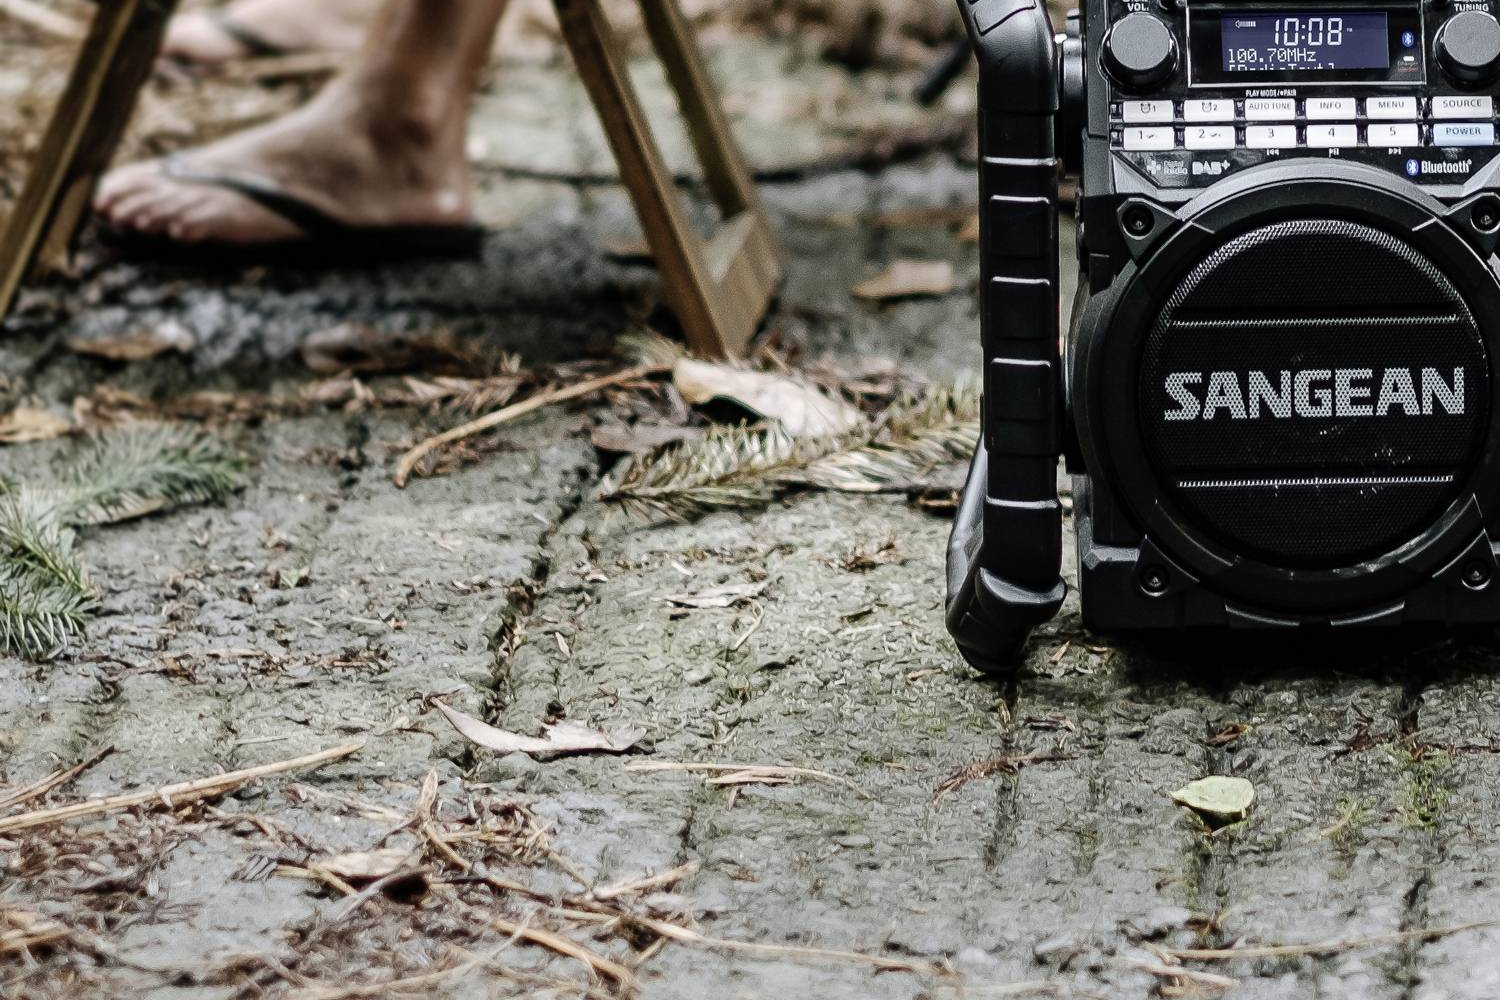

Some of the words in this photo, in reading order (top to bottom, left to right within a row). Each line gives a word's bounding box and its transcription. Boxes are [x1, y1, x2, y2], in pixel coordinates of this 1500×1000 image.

[1454, 3, 1489, 12] TUNING
[1274, 18, 1342, 46] 10:08
[1228, 48, 1317, 62] 100.70MHz
[1245, 89, 1260, 97] PLAY
[1249, 102, 1270, 110] AUTO
[1272, 102, 1291, 110] TUNE
[1319, 102, 1342, 110] INFO
[1378, 101, 1405, 109] MENU
[1442, 99, 1482, 108] SOURCE
[1198, 129, 1205, 139] 2
[1267, 129, 1275, 138] 3
[1327, 127, 1335, 137] 4
[1389, 127, 1396, 136] 5
[1445, 127, 1481, 136] POWER
[1164, 367, 1465, 420] SANGEAN
